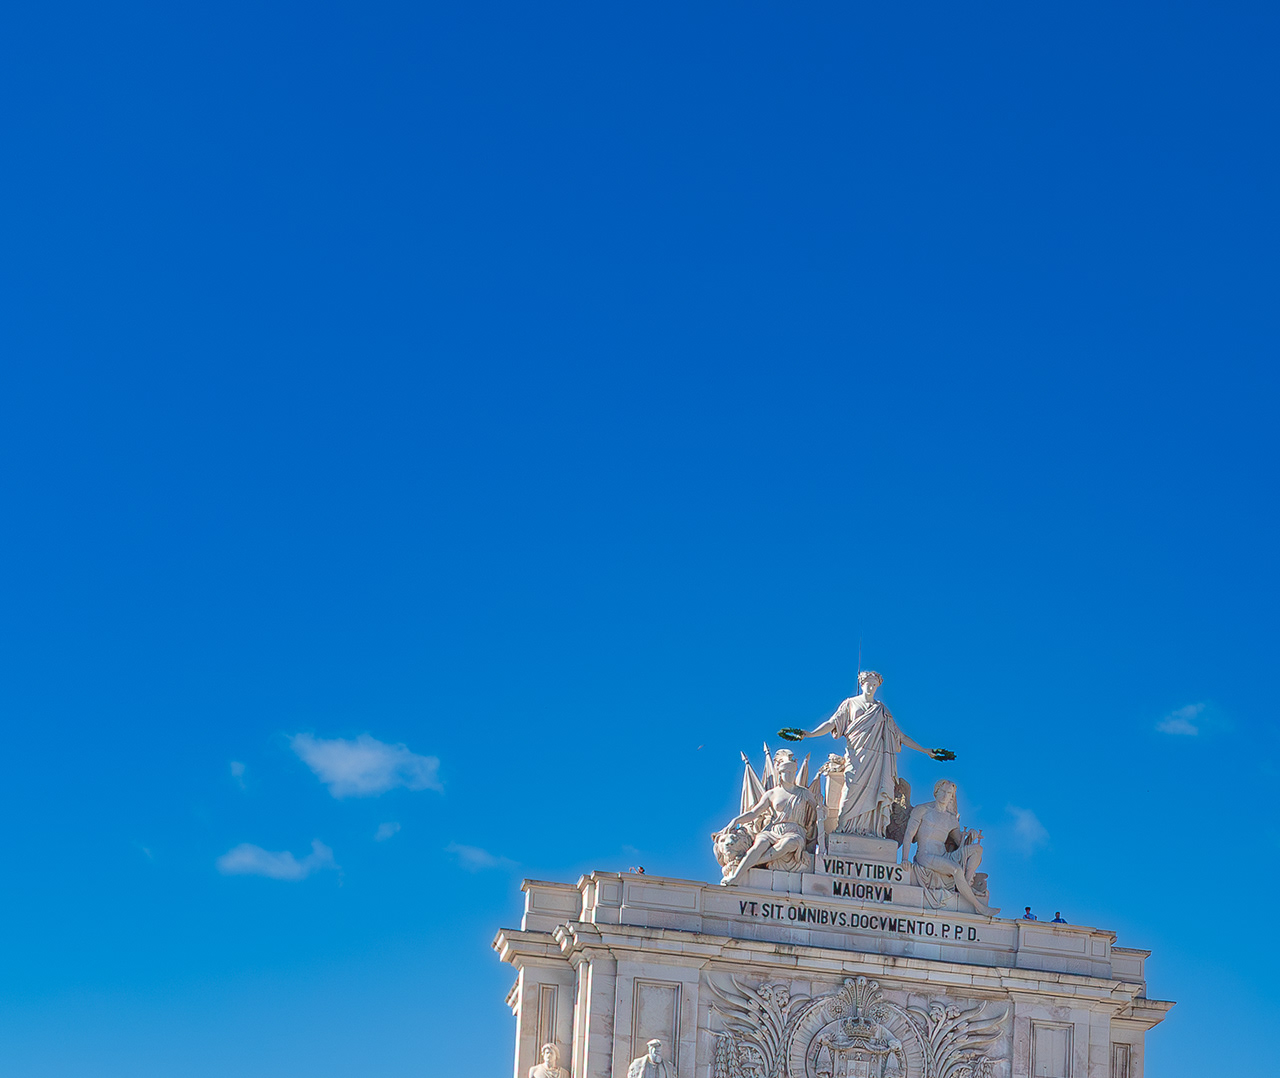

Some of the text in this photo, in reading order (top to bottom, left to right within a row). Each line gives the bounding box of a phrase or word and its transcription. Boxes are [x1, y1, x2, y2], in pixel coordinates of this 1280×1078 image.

[823, 858, 903, 882] VIRTVTIBVS
[832, 881, 893, 902] MAIORVM
[739, 900, 758, 916] VT.
[761, 903, 785, 920] SIT.
[967, 926, 980, 942] D.
